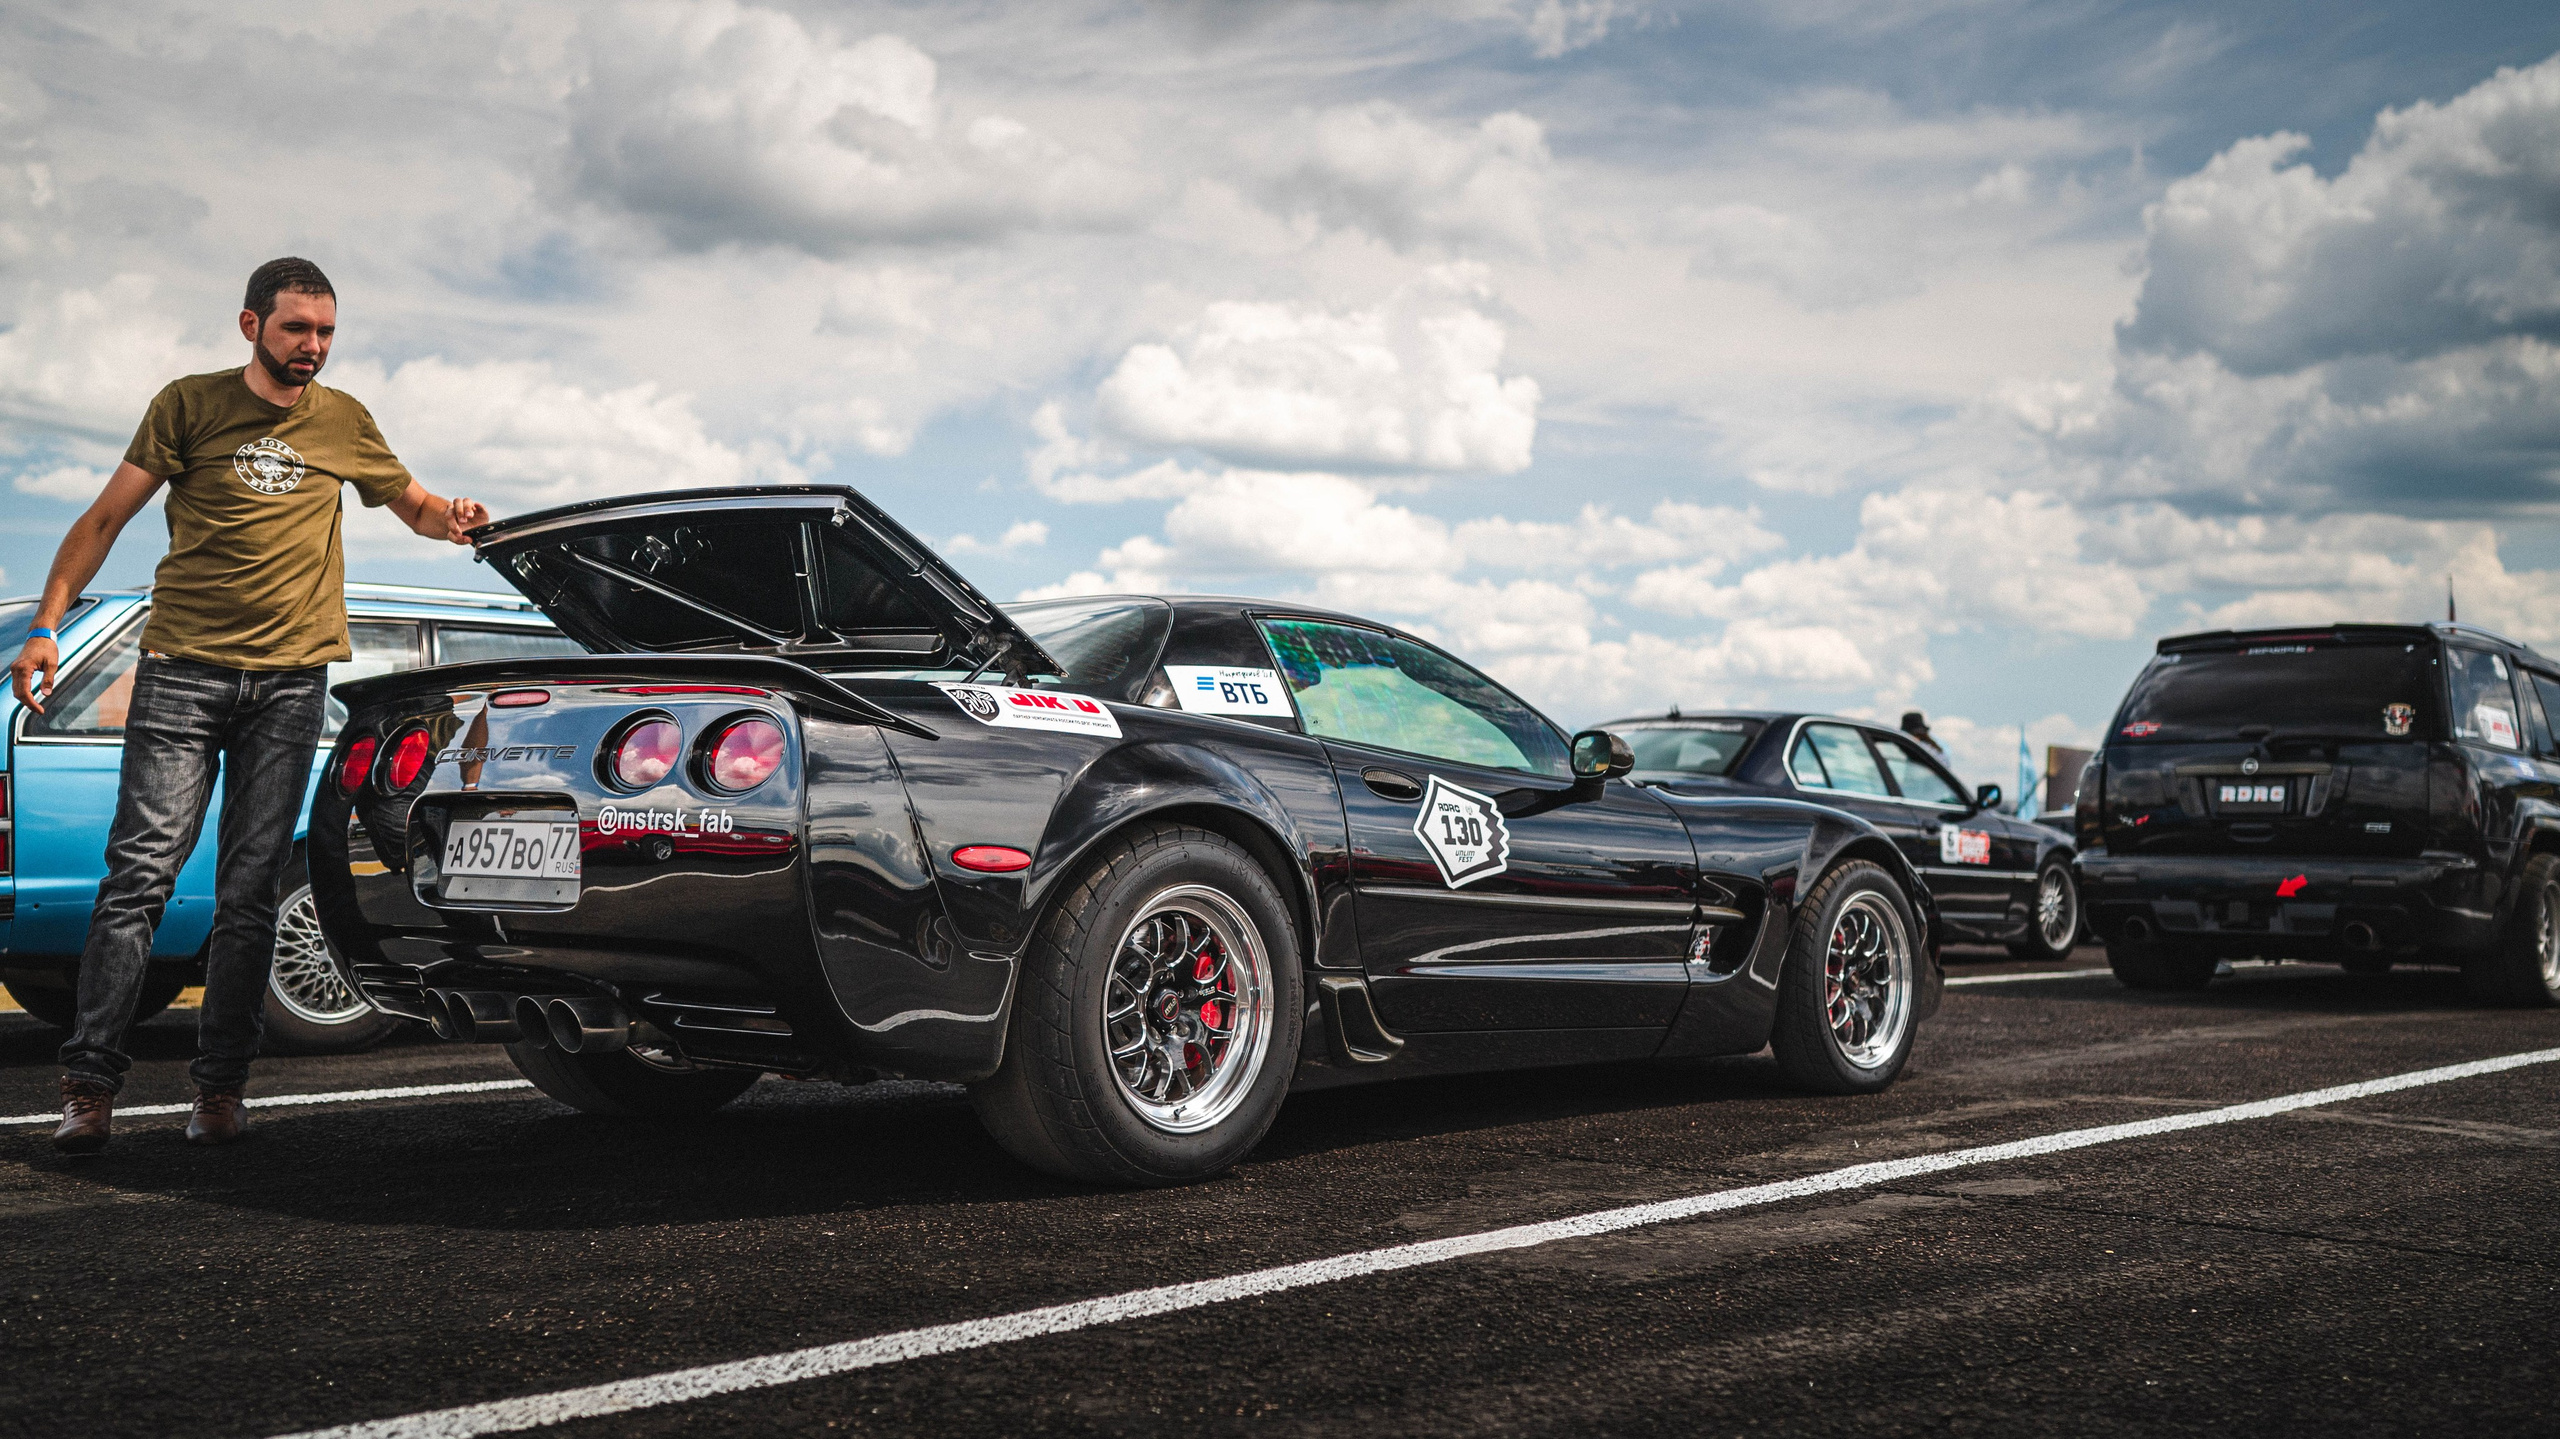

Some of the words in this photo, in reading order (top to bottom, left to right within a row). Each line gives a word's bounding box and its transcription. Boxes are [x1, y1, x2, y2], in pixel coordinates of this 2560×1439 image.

[250, 478, 274, 492] BIG
[1219, 682, 1269, 705] ВТБ
[435, 745, 578, 764] CORVETTE
[598, 805, 733, 838] @mstrsk_fab
[1441, 815, 1483, 847] 130
[550, 827, 580, 860] 77
[554, 861, 574, 874] RUS
